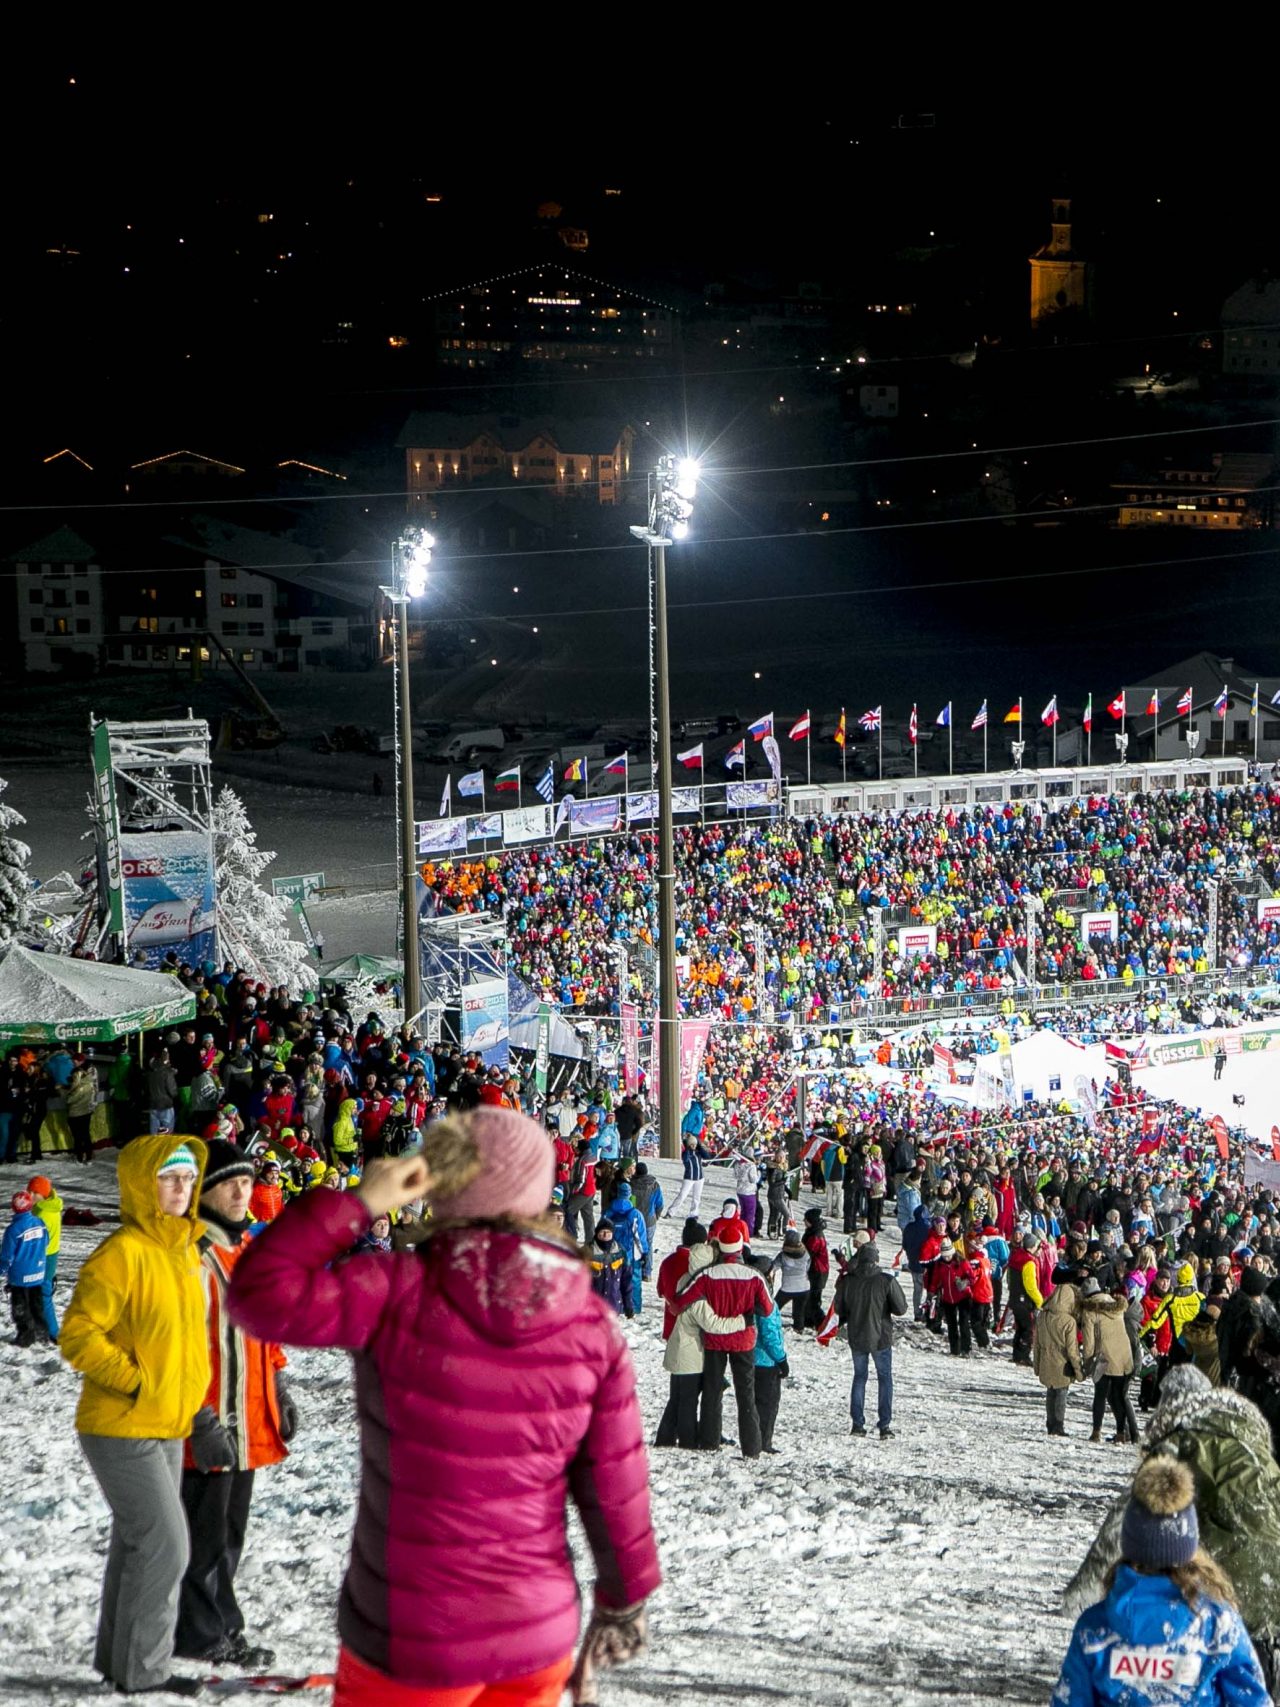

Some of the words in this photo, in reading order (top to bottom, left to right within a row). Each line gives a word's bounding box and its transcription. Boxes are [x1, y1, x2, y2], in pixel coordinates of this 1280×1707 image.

[276, 885, 301, 895] EXIT
[55, 1024, 98, 1040] Gösser
[1115, 1656, 1174, 1680] AVIS
